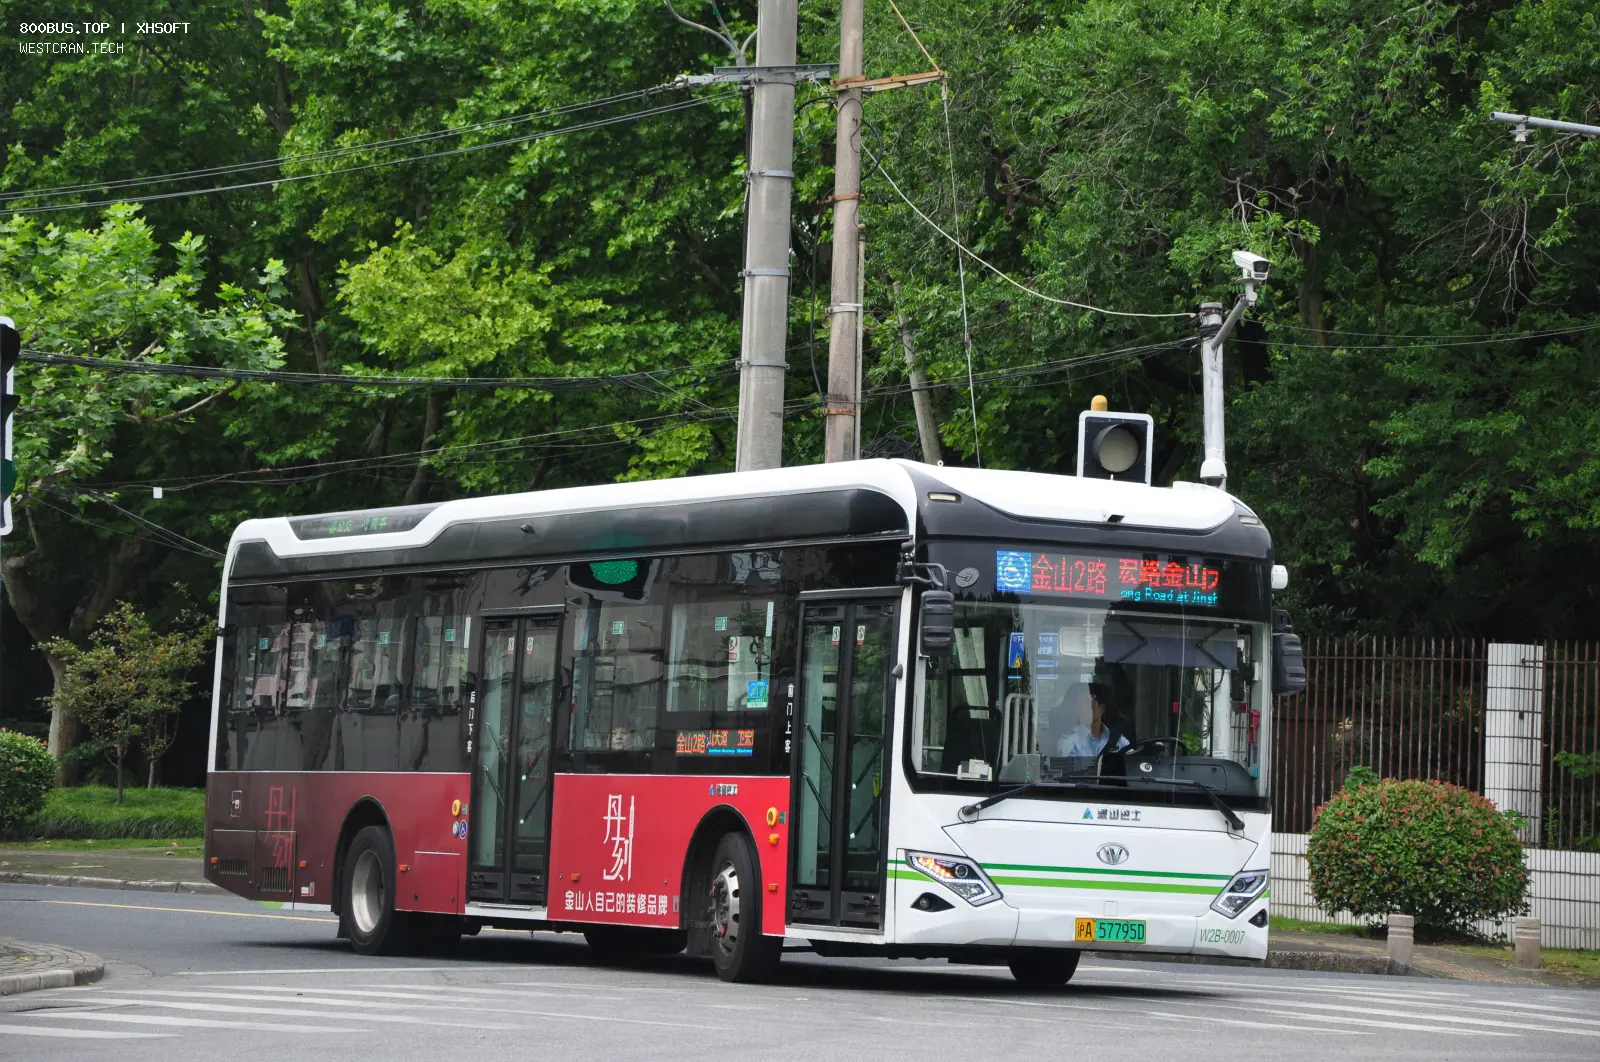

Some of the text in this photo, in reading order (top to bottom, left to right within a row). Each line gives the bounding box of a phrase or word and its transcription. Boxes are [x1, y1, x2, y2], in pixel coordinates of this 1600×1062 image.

[1032, 553, 1108, 595] 金山2路
[1145, 587, 1174, 601] Road
[1176, 591, 1189, 602] at
[676, 732, 706, 754] 金山2路
[565, 890, 668, 916] 金山人自己的装修品牌
[1099, 922, 1145, 940] 57795D
[1200, 928, 1246, 945] W2B-0007
